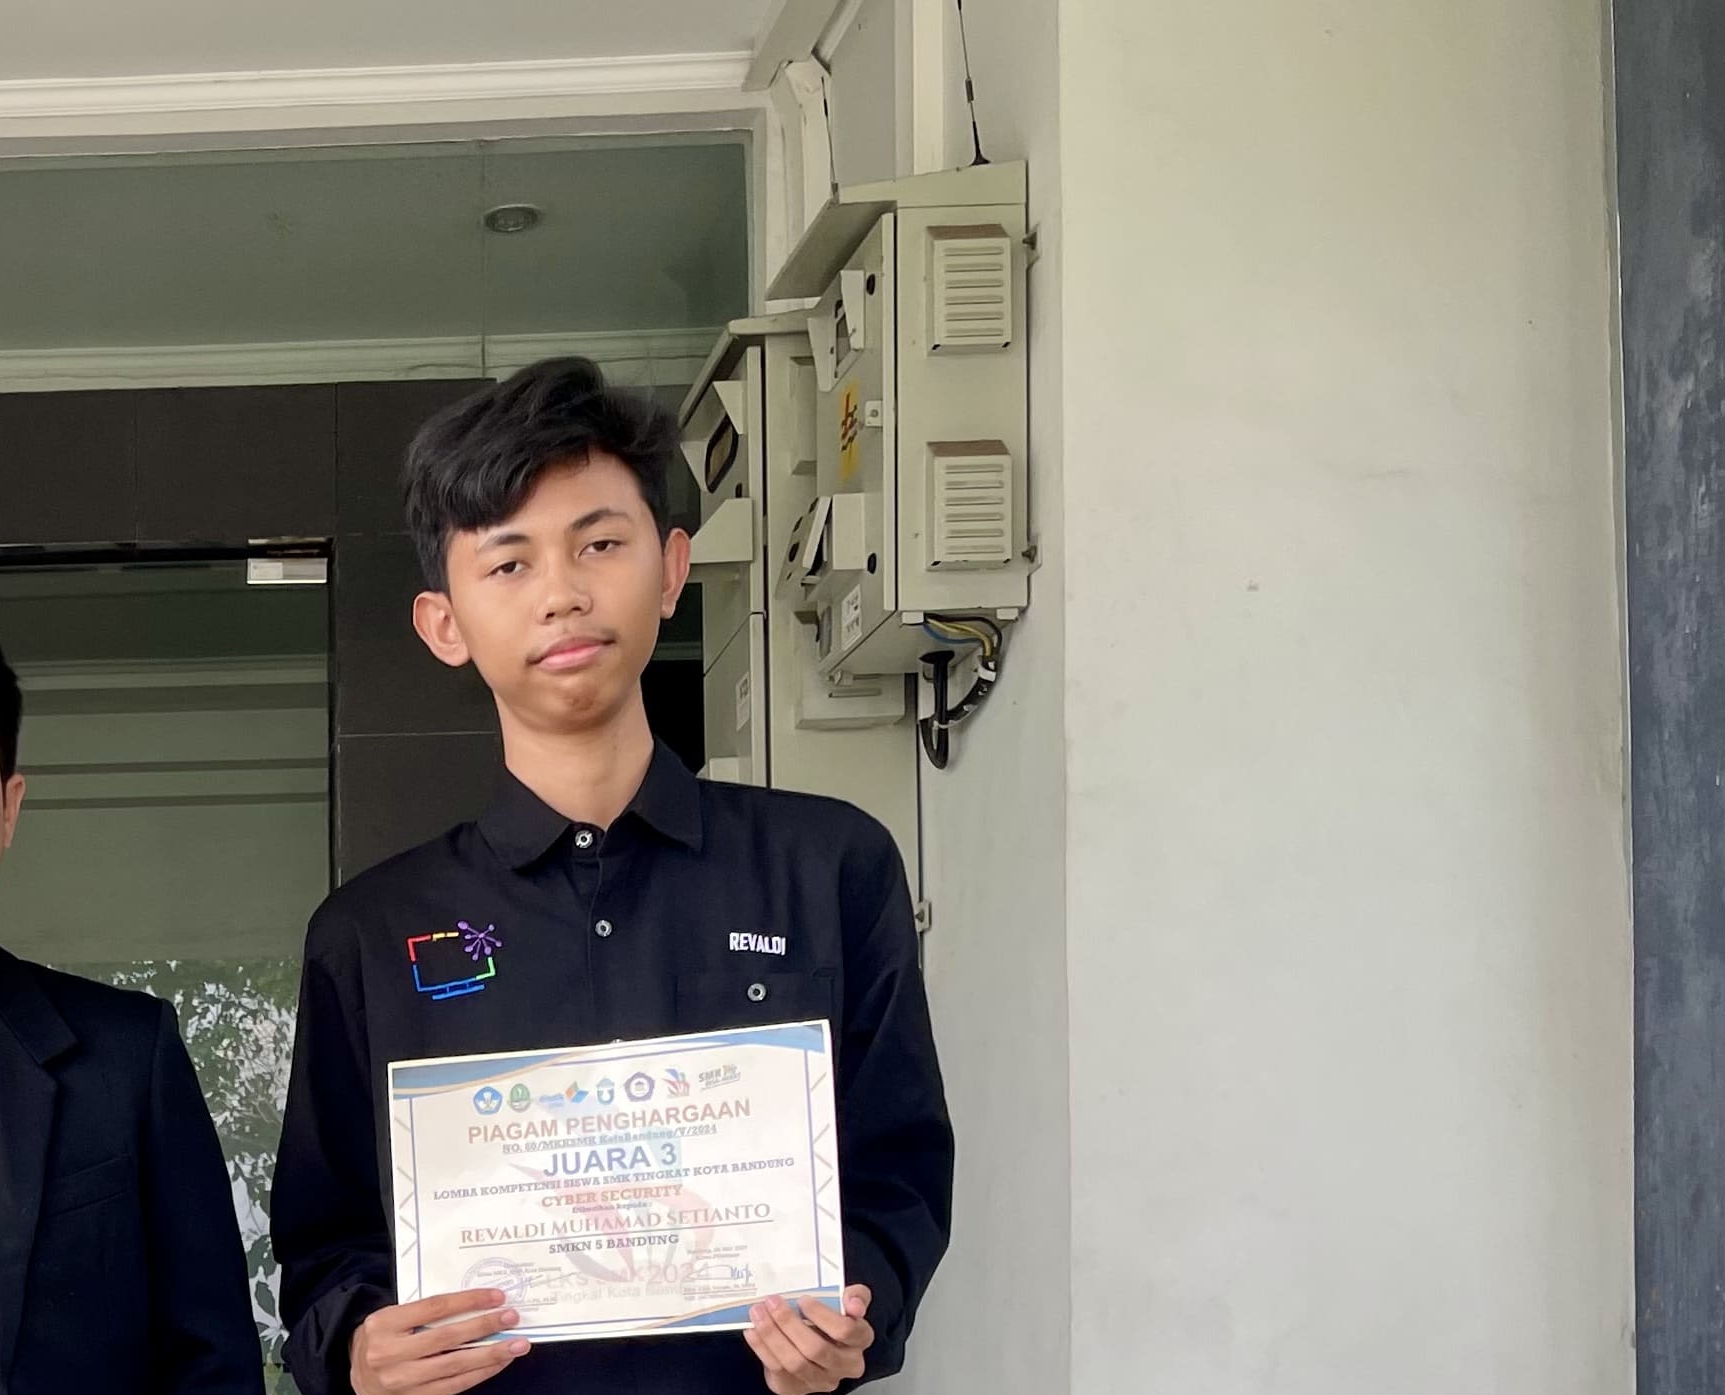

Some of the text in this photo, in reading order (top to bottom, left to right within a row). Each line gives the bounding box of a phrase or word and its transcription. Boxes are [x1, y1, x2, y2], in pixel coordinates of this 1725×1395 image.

[729, 931, 786, 956] REVALDI
[468, 1119, 558, 1144] PIAGAM
[566, 1098, 751, 1136] PENGHARGAAN
[543, 1142, 677, 1177] JUARA 3
[434, 1157, 795, 1200] LOMBA KOMPETENSI SISWA SMK TINGKAT KOTA BANDUNG
[541, 1184, 684, 1208] CYBER SECURITY
[461, 1202, 771, 1243] REVALDI MUHAMAD SETIANTO
[549, 1234, 679, 1254] SMKN 5 BANDUNG
